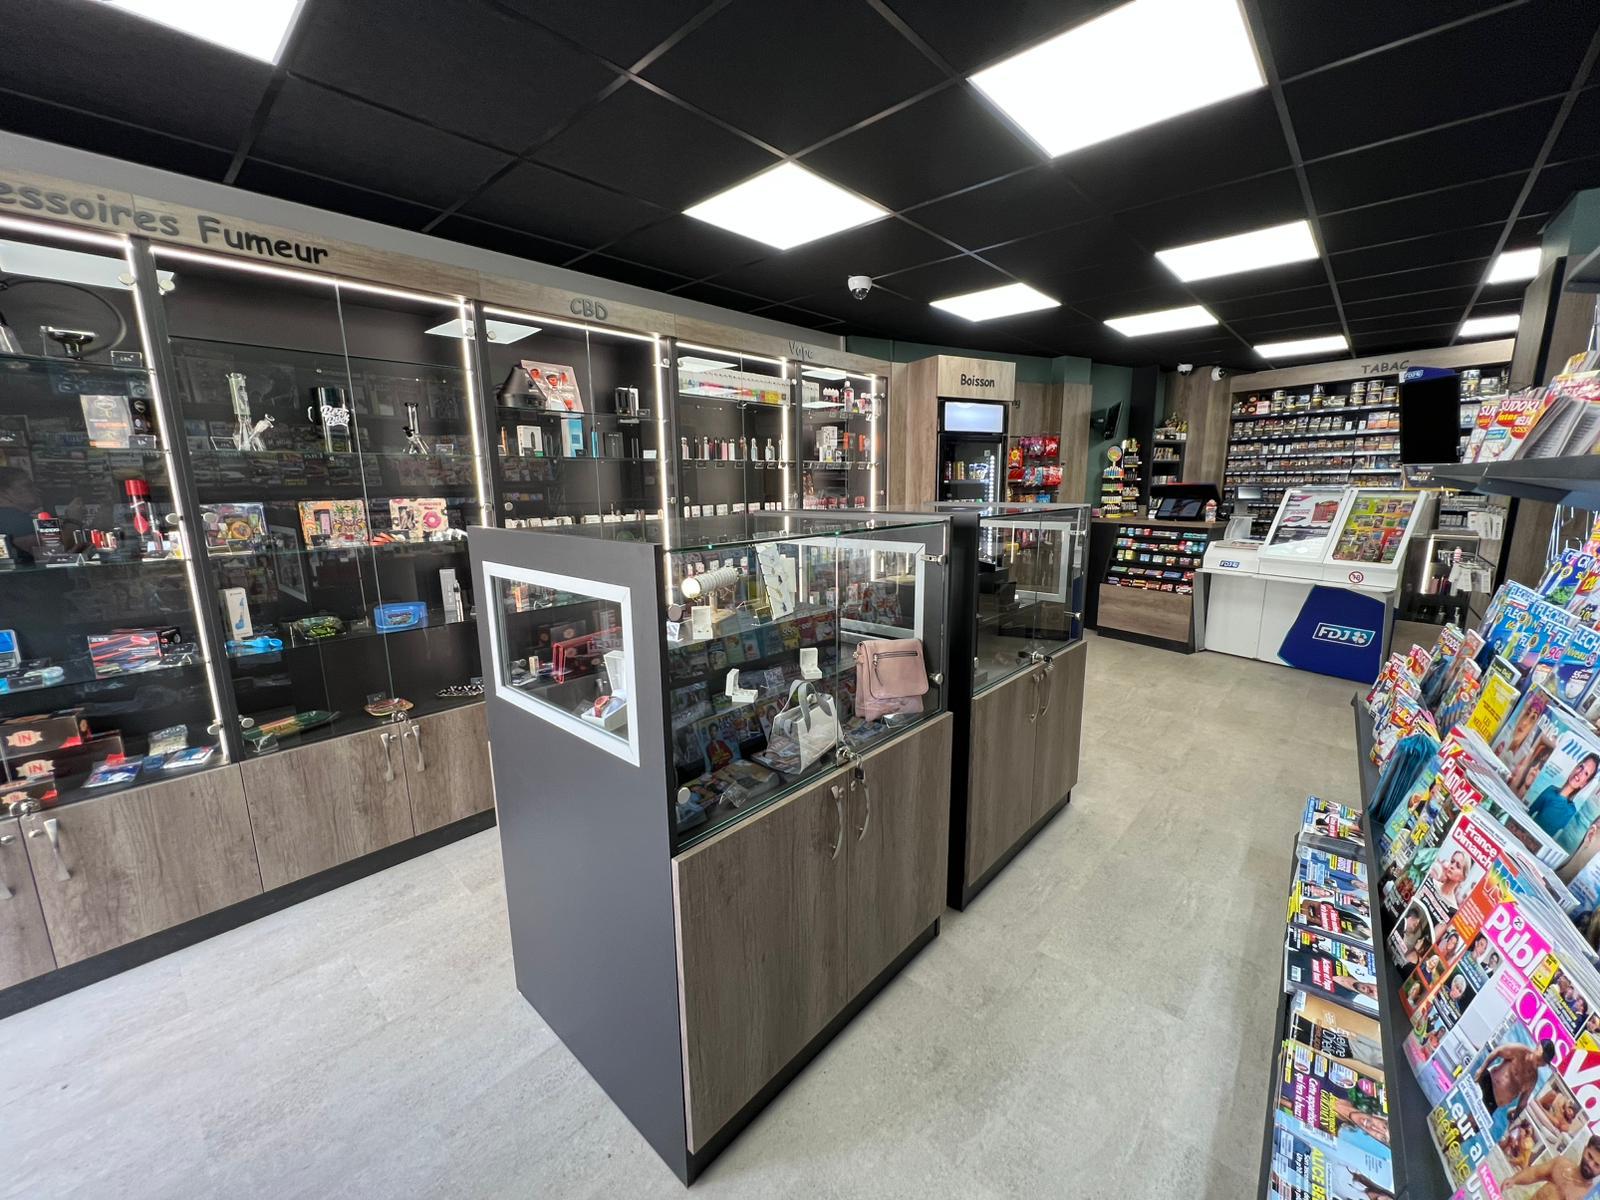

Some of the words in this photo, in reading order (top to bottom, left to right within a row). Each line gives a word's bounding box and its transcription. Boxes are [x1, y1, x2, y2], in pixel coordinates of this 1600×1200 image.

[197, 215, 328, 264] Fumeur
[570, 298, 608, 321] CBD
[788, 340, 814, 361] Vape
[960, 373, 995, 388] Boisson
[1361, 360, 1409, 374] TABAC
[1318, 626, 1350, 642] FDJ
[18, 734, 32, 743] IN
[28, 763, 42, 774] IN
[1464, 823, 1499, 857] France
[1485, 906, 1547, 977] Publ
[1515, 987, 1570, 1067] Clos
[1447, 1086, 1476, 1141] Leur
[1433, 1106, 1462, 1160] défie
[1456, 1154, 1472, 1182] le
[1312, 1146, 1323, 1182] ALICE
